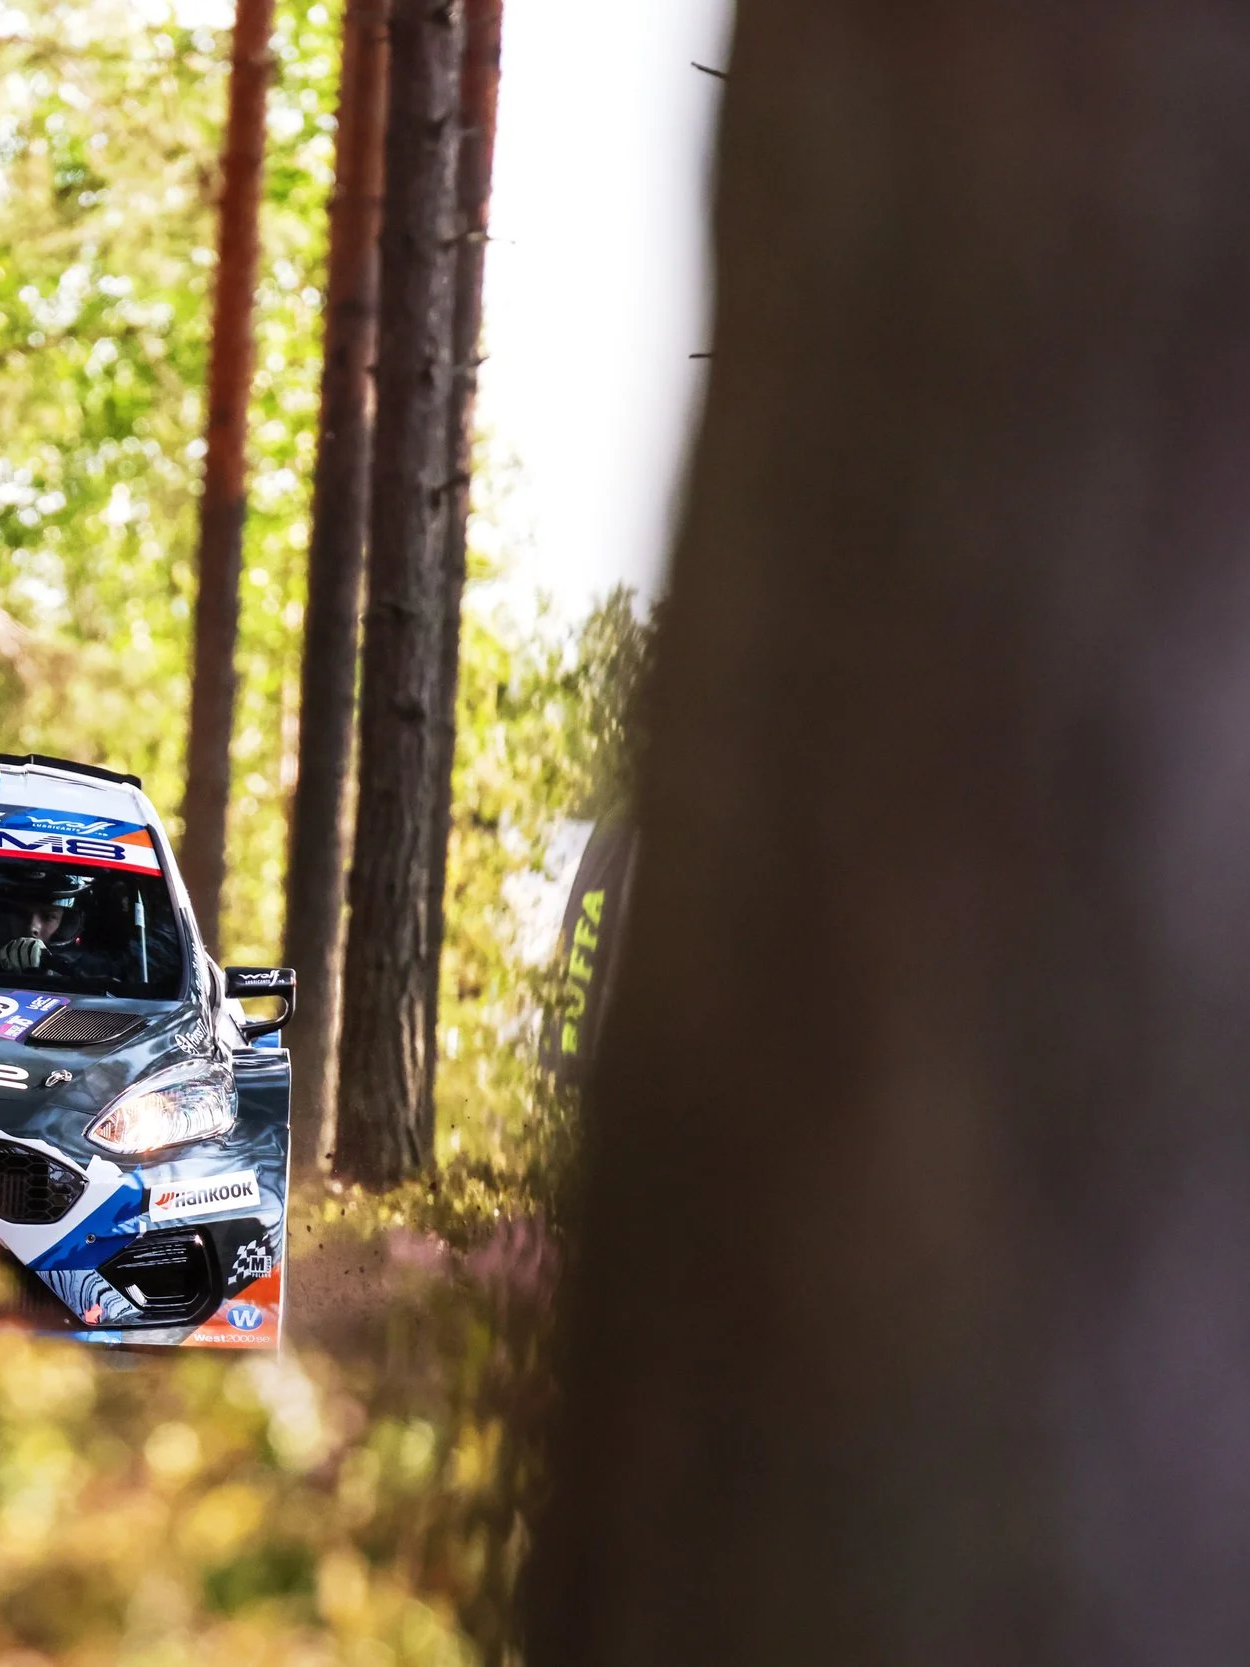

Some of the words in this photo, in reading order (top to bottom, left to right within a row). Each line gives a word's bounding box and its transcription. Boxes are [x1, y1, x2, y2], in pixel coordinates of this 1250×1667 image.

[32, 823, 80, 832] LUBRICANTS
[251, 1257, 265, 1272] M
[232, 1309, 259, 1327] W
[193, 1333, 270, 1343] West2000.se
